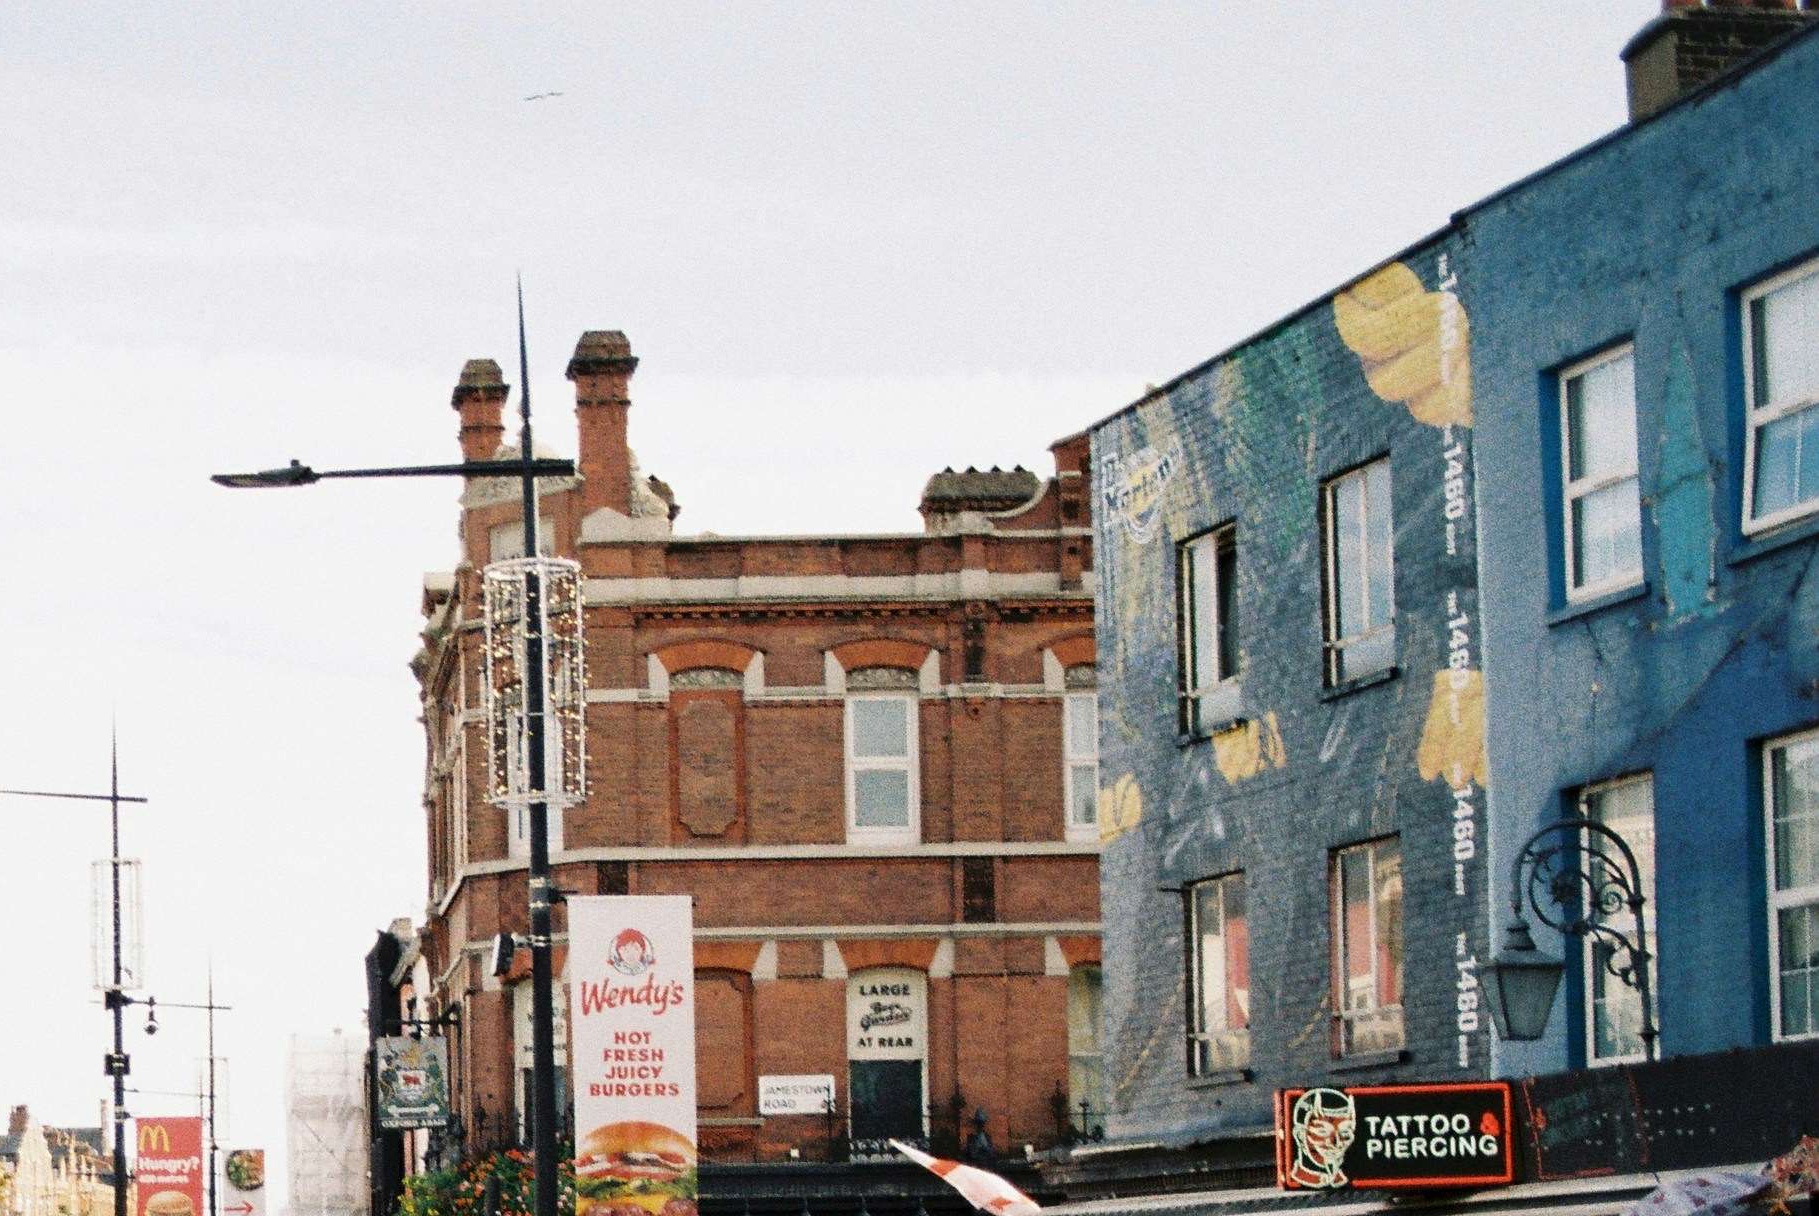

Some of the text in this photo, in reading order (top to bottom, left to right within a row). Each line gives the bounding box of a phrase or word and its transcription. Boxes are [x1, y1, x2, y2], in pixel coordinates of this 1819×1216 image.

[1443, 444, 1464, 519] 1460
[1452, 784, 1475, 861] 1460
[581, 972, 685, 1016] Wendy's
[859, 983, 911, 996] LARGE
[1456, 955, 1478, 1032] 1460
[614, 1032, 652, 1045] HOT
[857, 1037, 913, 1048] AT REAR
[603, 1049, 664, 1062] FRESH
[604, 1066, 663, 1080] JUICY
[589, 1082, 680, 1097] BURGERS
[1365, 1112, 1500, 1135] TATTOO &
[1366, 1135, 1499, 1159] PIERCING
[139, 1157, 200, 1174] Hungry?
